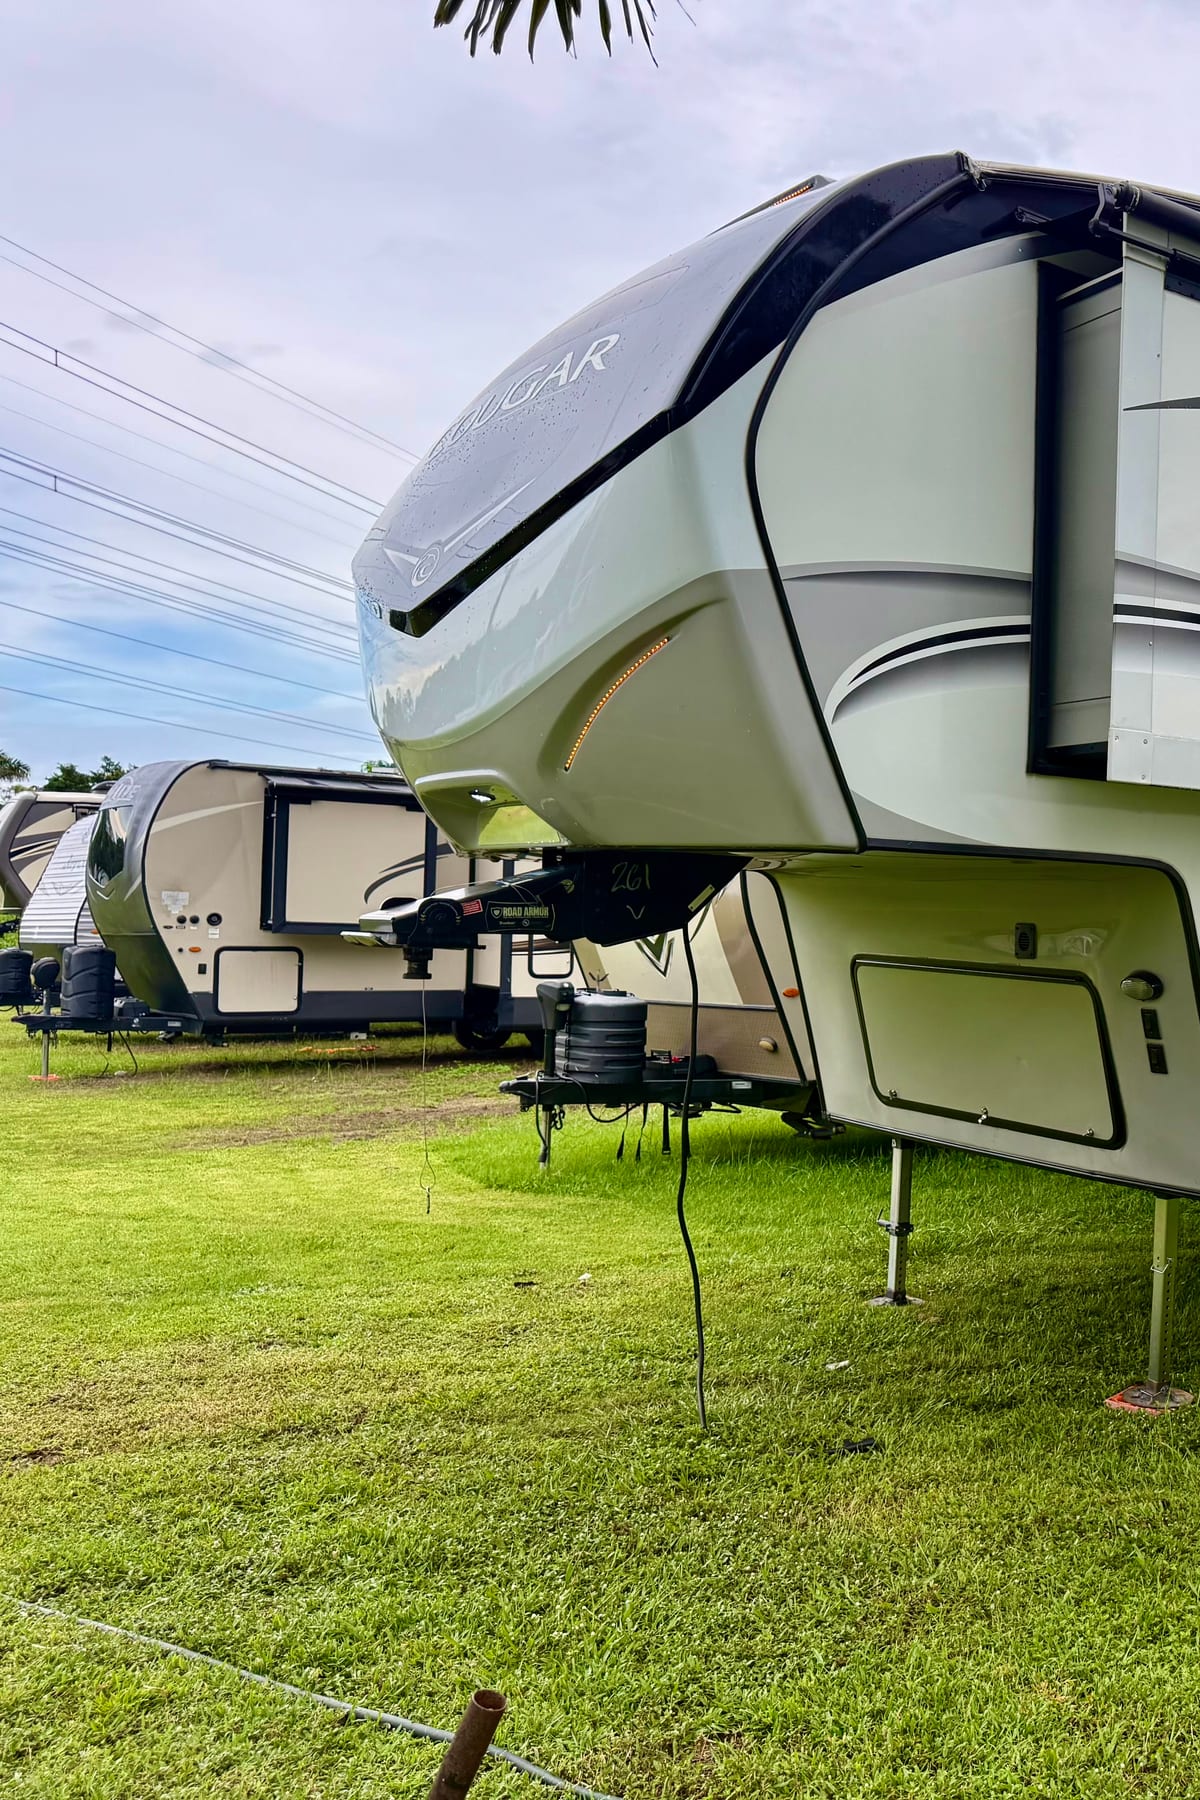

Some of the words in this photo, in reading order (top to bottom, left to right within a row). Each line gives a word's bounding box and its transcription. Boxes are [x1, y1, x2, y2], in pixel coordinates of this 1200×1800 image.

[611, 861, 651, 892] 261
[502, 906, 522, 918] ROAD
[523, 906, 549, 918] ARMOR
